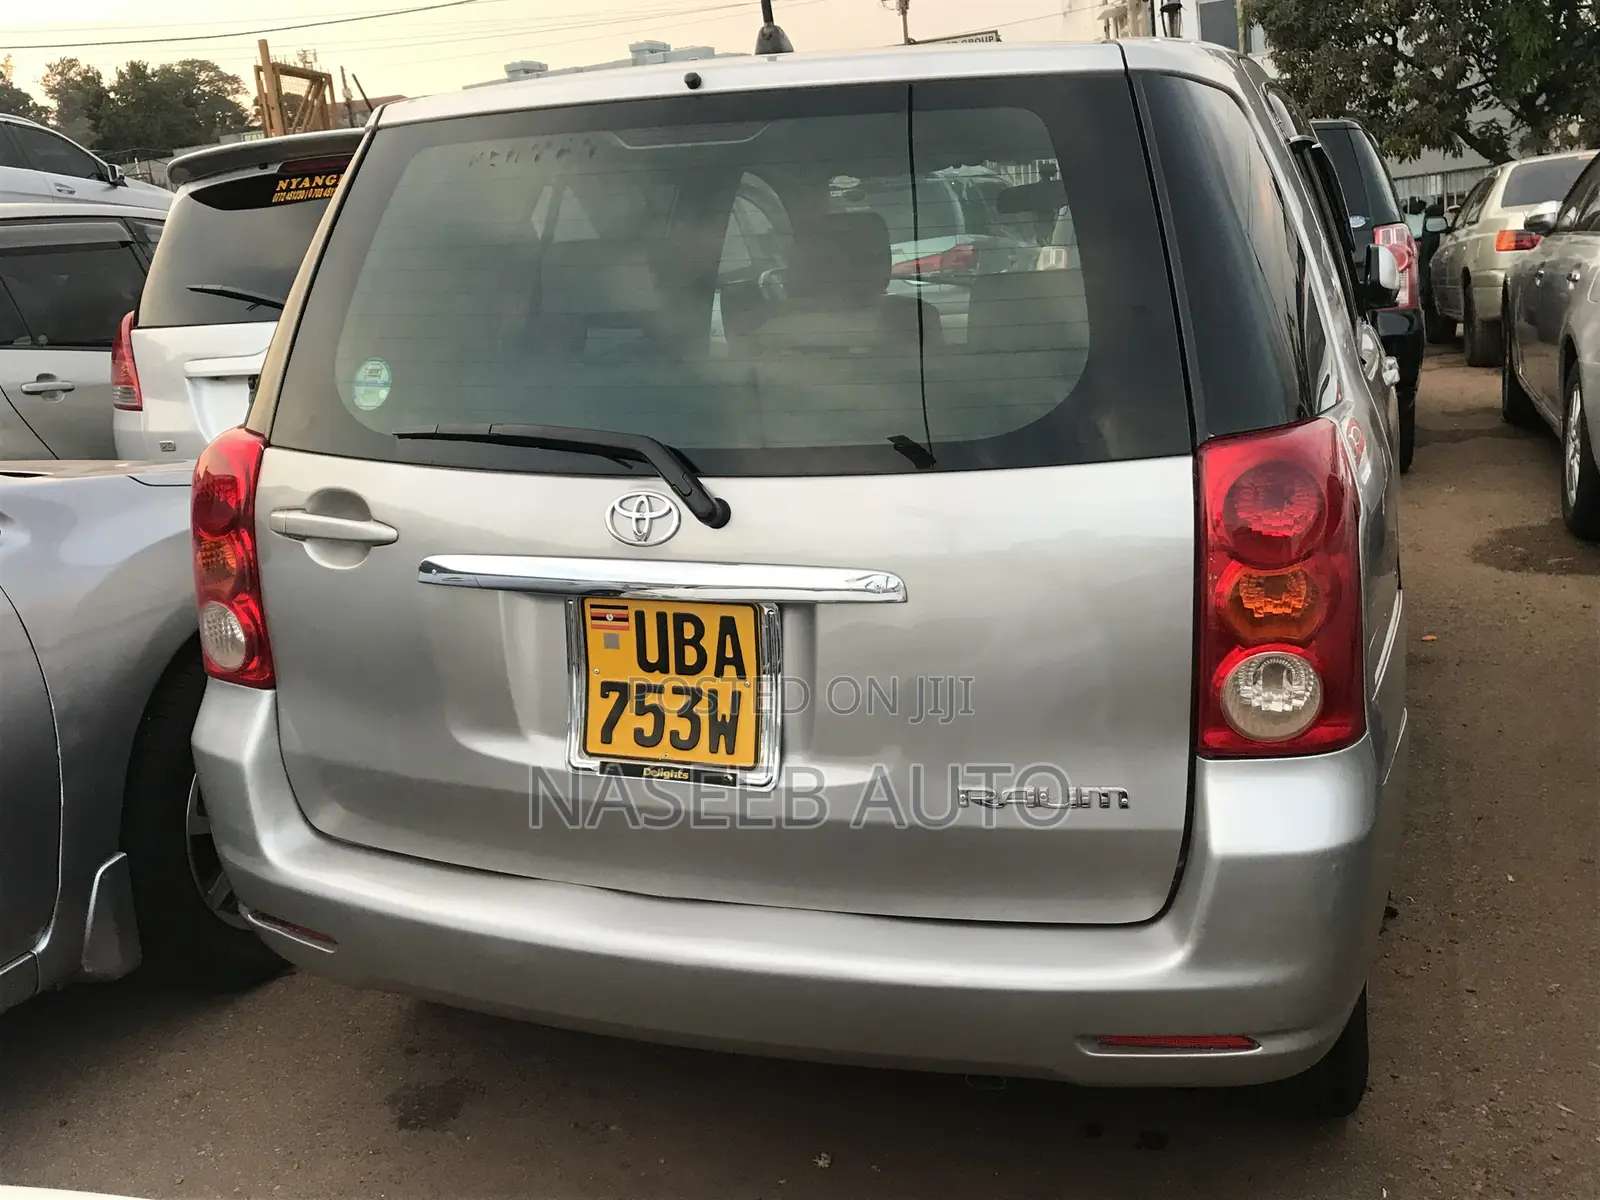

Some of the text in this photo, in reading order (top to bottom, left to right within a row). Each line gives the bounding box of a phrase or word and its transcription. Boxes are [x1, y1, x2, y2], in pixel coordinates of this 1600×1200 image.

[272, 191, 286, 203] 0772
[634, 609, 746, 680] UBA
[600, 680, 742, 755] 753W
[642, 766, 689, 780] Delights
